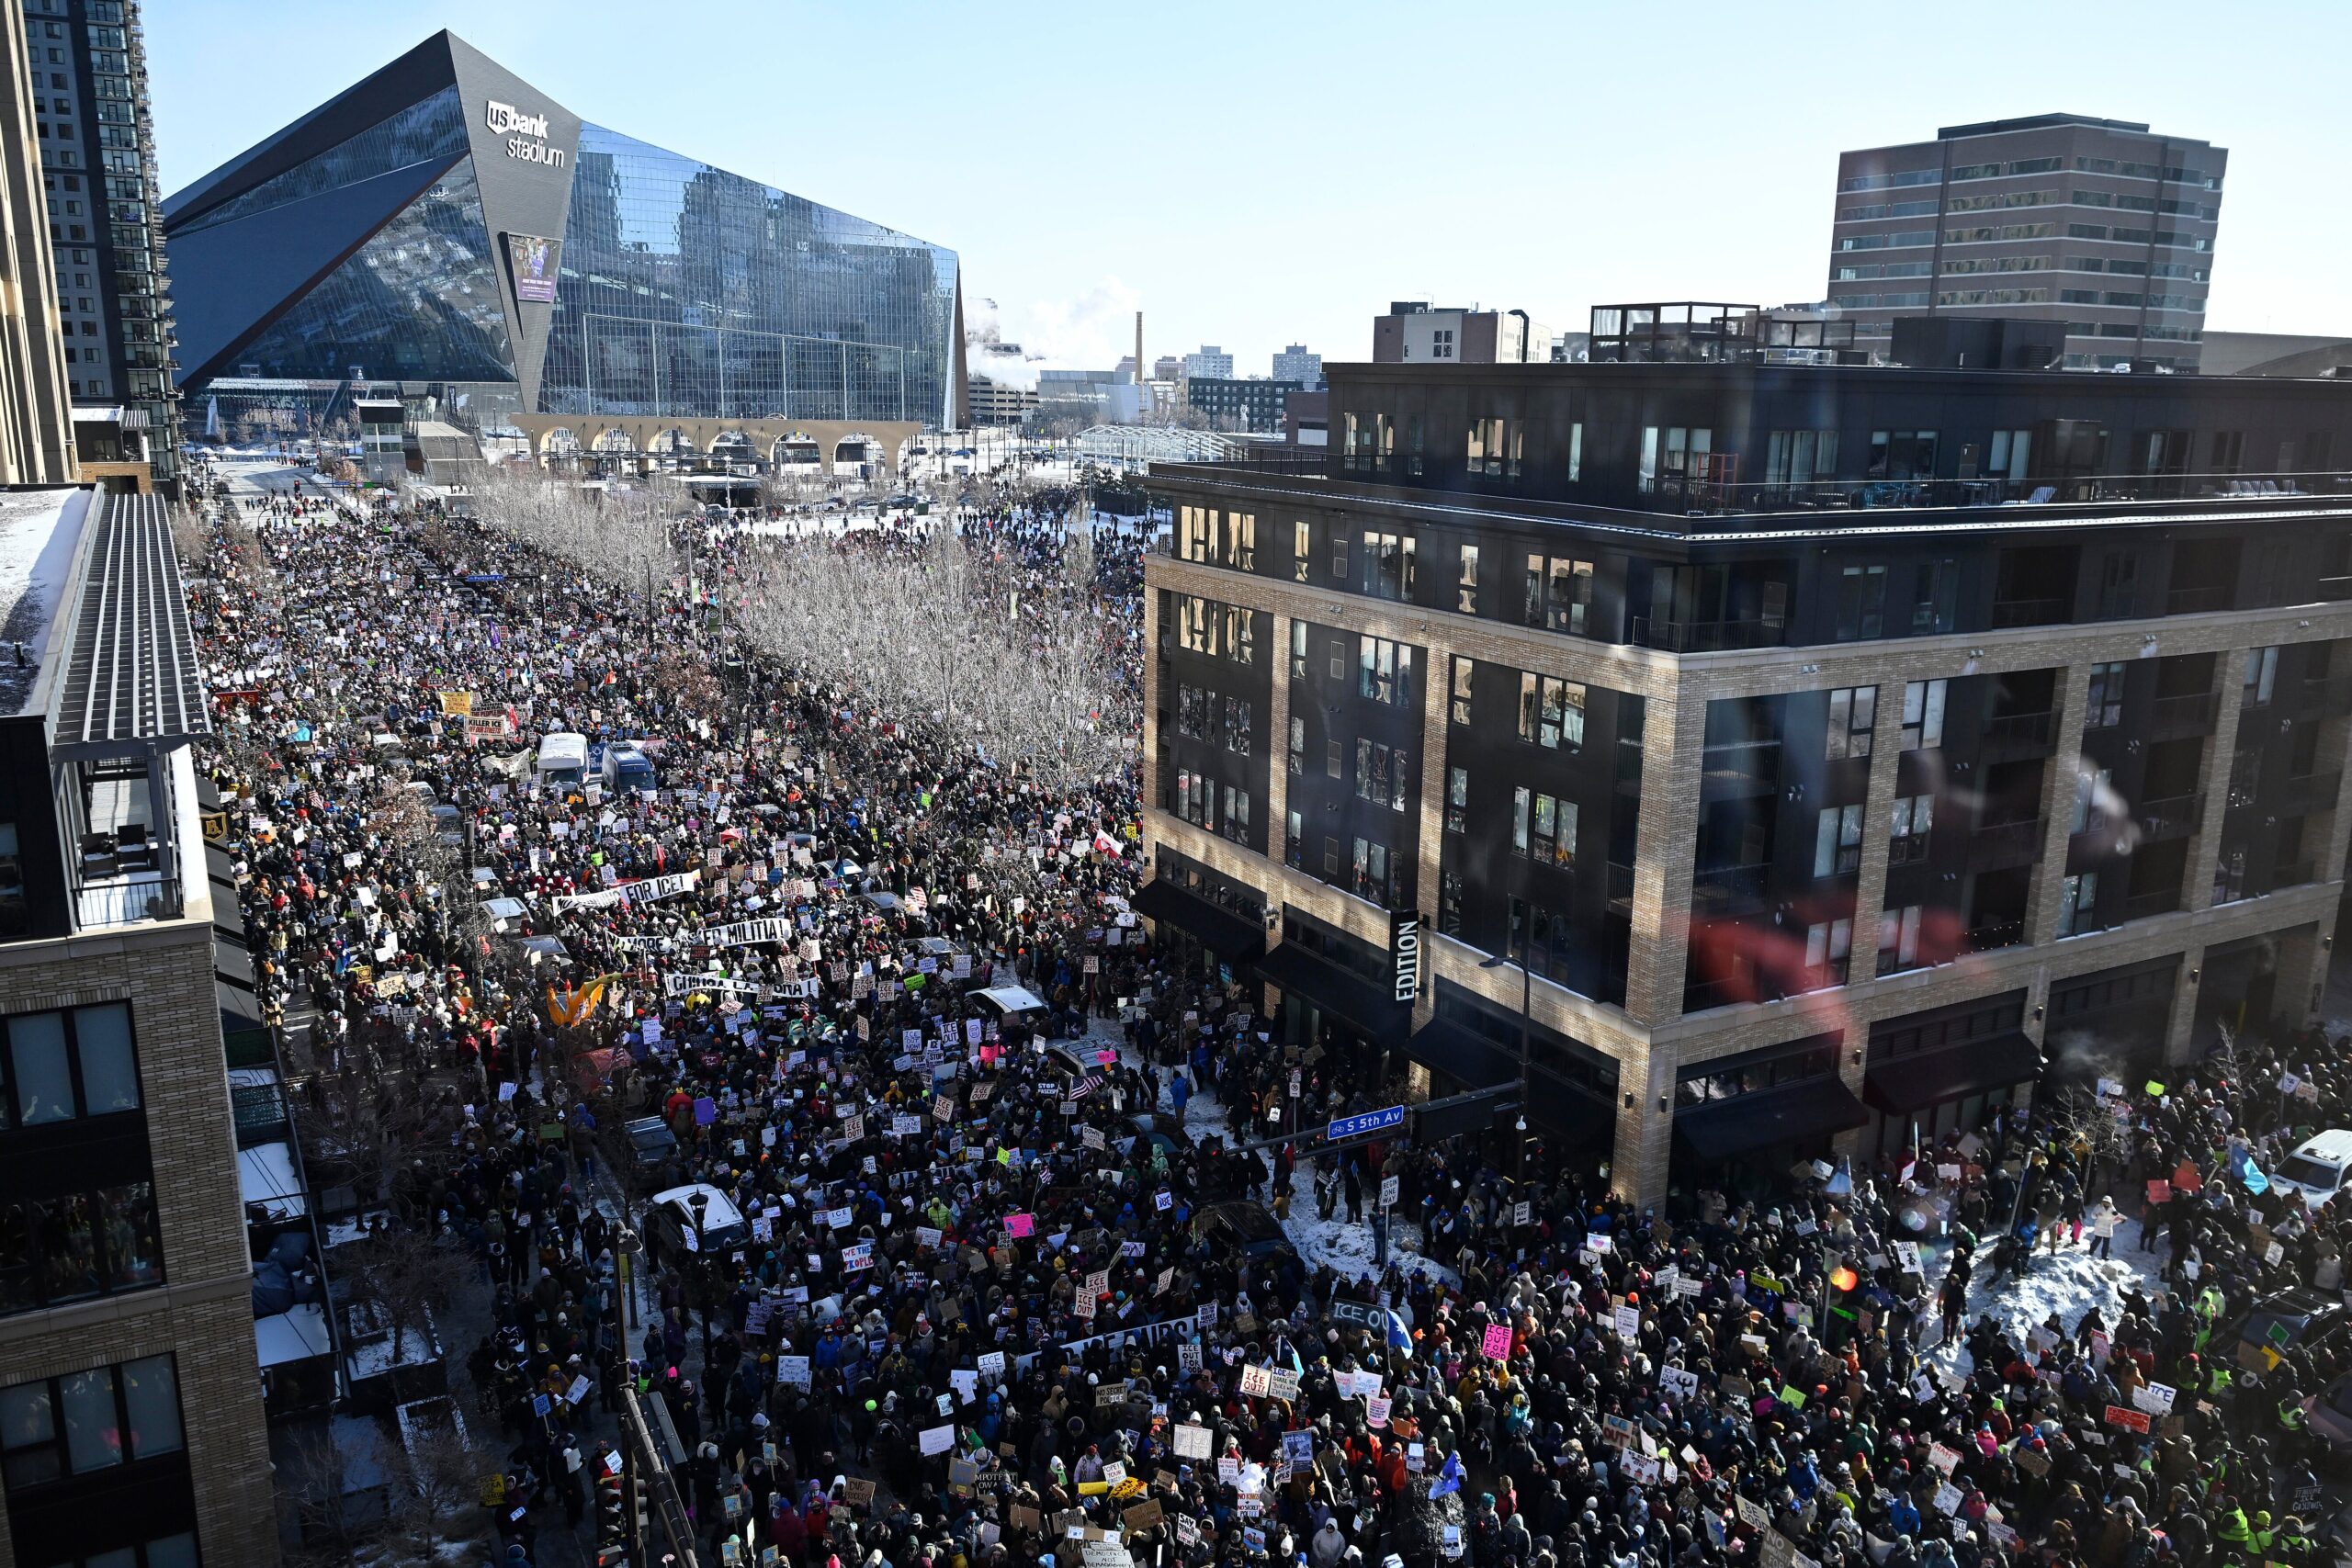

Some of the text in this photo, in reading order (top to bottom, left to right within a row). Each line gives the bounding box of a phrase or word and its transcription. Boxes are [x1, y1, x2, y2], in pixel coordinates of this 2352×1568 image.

[507, 137, 564, 168] stadium
[626, 884, 653, 905] FOR
[657, 874, 684, 897] ICE!
[797, 905, 808, 913] MN
[727, 919, 786, 944] MILITIA!
[1396, 920, 1418, 1001] EDITION
[382, 978, 397, 987] ICE
[859, 1021, 867, 1030] ICE
[943, 1023, 957, 1033] ICE
[943, 1032, 956, 1043] OUT
[930, 1041, 938, 1049] ICE
[929, 1052, 944, 1061] STOP
[936, 1100, 950, 1111] ICE
[934, 1106, 949, 1118] OUT!
[846, 1122, 861, 1131] ICE
[1347, 1111, 1400, 1132] S 5th Av
[847, 1129, 863, 1139] OUT!
[1084, 1127, 1100, 1138] DOWN
[1383, 1178, 1397, 1190] BEGIN
[1384, 1187, 1396, 1197] ONE
[1383, 1196, 1396, 1205] WAY
[831, 1209, 847, 1218] ICE
[1083, 1229, 1096, 1237] ICE
[843, 1246, 872, 1258] WE THE
[844, 1257, 874, 1272] PEOPLE
[1089, 1277, 1105, 1288] ICE
[1078, 1294, 1092, 1306] ICE
[1076, 1304, 1093, 1317] OUT!
[1334, 1303, 1363, 1323] ICE
[1487, 1325, 1510, 1337] ICE
[1486, 1334, 1509, 1345] OUT
[1485, 1341, 1506, 1353] FOR
[979, 1353, 1001, 1367] ICE
[1484, 1349, 1506, 1360] GOOD
[980, 1365, 1001, 1377] OUT
[1272, 1367, 1287, 1377] ICE
[1245, 1373, 1265, 1384] ICE
[1096, 1386, 1127, 1397] NO SECRET
[1243, 1381, 1266, 1393] OUT!
[2151, 1384, 2174, 1404] ICE
[1603, 1427, 1630, 1447] OUT
[1933, 1443, 1954, 1461] HATE
[849, 1480, 865, 1491] DUE
[1113, 1480, 1133, 1495] LOVE
[1744, 1503, 1760, 1518] BE
[1180, 1514, 1194, 1528] SAY
[1841, 1518, 1852, 1529] ICE
[1955, 1518, 1966, 1531] ICE
[1766, 1531, 1786, 1549] NO
[1954, 1529, 1965, 1540] OUT
